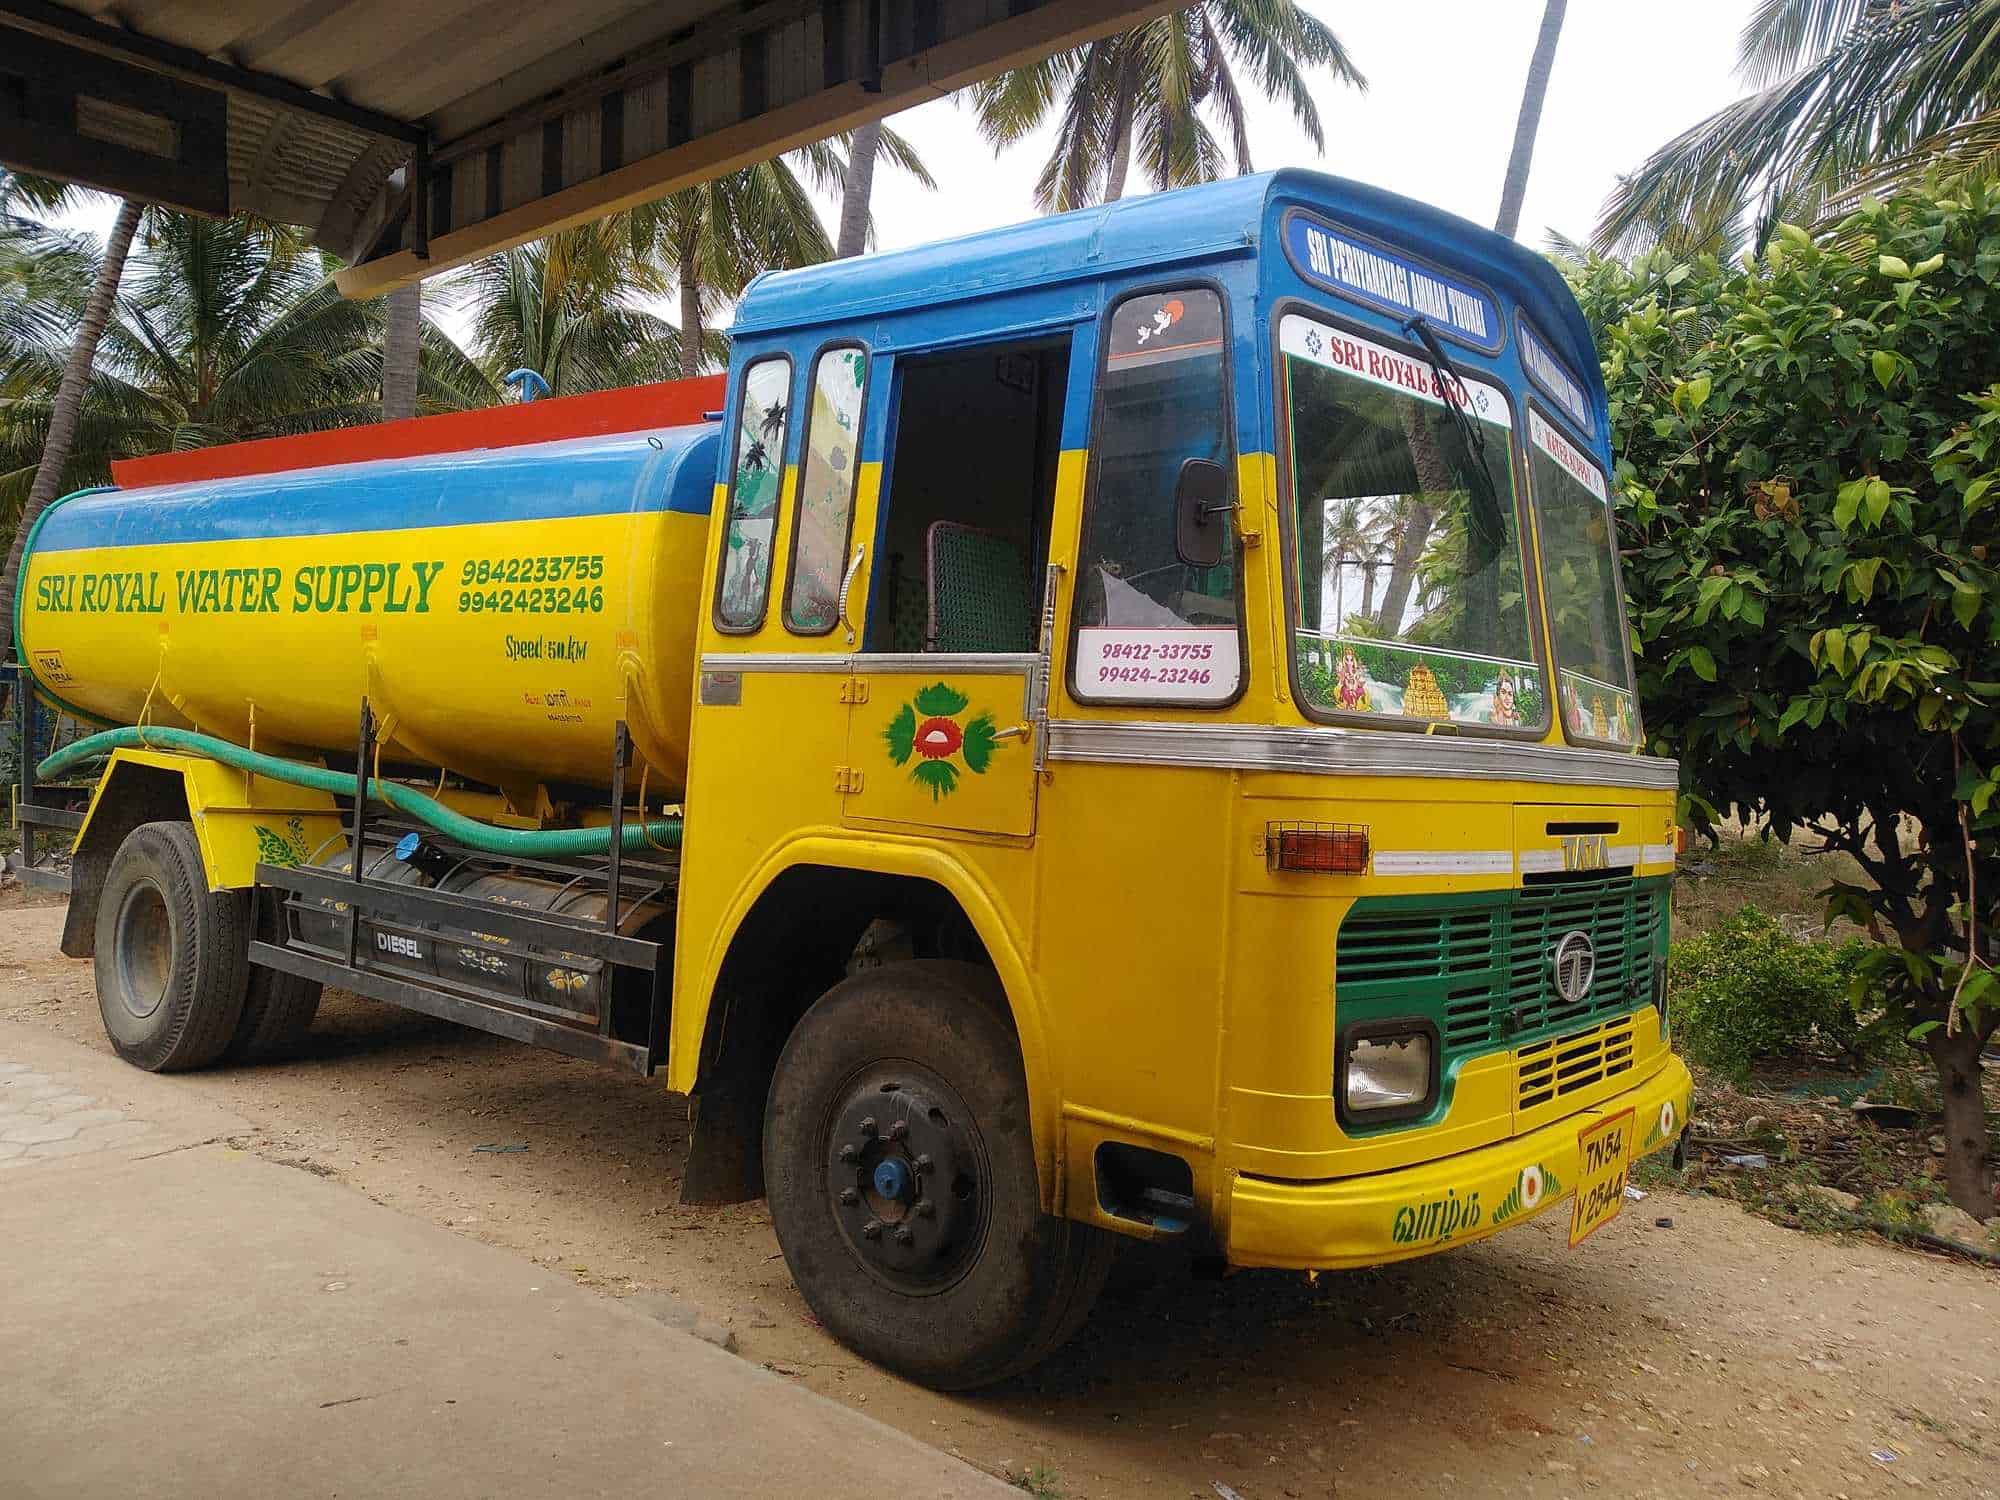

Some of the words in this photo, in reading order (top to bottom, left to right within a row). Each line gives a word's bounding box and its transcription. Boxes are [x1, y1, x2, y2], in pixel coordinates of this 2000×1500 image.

[1306, 227, 1331, 277] SRI
[1331, 336, 1364, 372] SRI
[1368, 350, 1428, 394] ROYAL
[461, 555, 604, 586] 9842233755
[36, 574, 76, 613] SRI
[79, 571, 165, 613] ROYAL
[176, 567, 282, 613] WATER
[293, 561, 445, 613] SUPPLY
[458, 585, 603, 613] 9942423246
[1102, 643, 1213, 660] 98422-33755
[1099, 667, 1211, 684] 99424-23246
[1561, 835, 1609, 871] TATA
[377, 932, 423, 959] DIESEL
